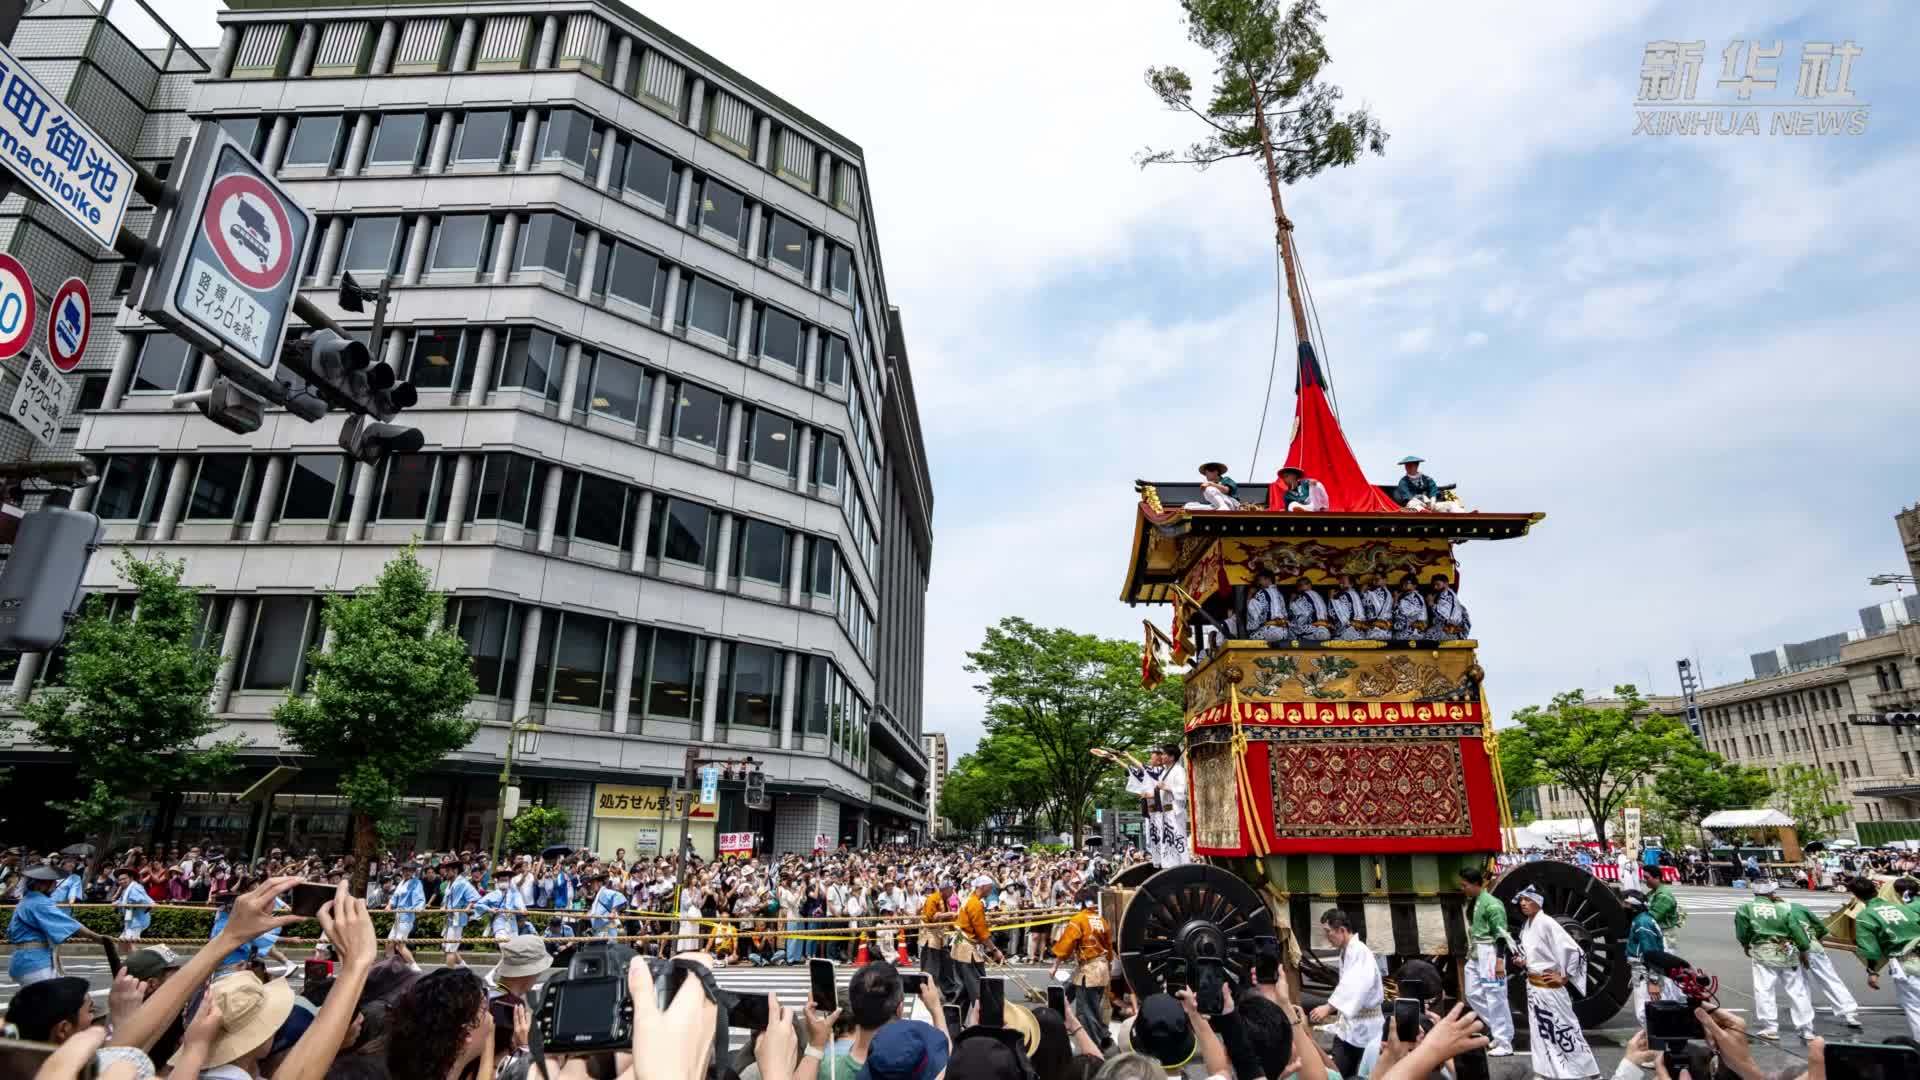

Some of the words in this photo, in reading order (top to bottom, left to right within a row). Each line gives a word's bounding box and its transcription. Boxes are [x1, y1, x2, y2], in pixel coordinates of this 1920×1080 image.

[0, 60, 119, 204] 町御池
[0, 280, 22, 334] 0
[195, 288, 259, 347] マイクロを除く
